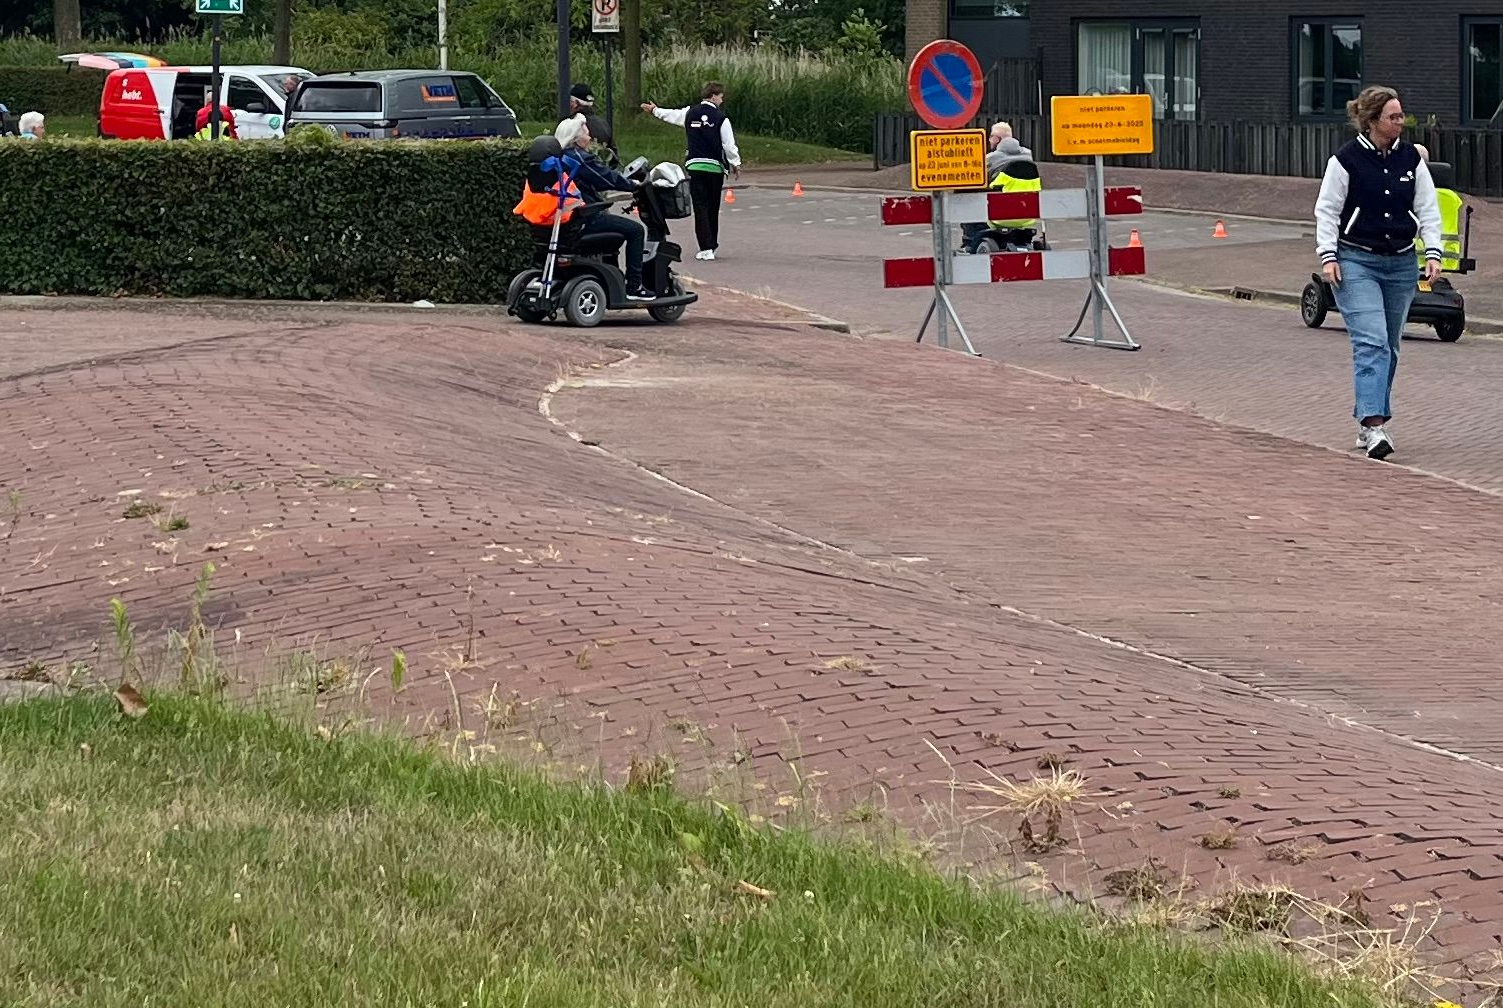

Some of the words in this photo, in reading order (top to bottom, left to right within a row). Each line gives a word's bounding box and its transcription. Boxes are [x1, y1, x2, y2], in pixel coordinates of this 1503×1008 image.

[919, 138, 938, 147] niet
[940, 136, 980, 147] parkeren
[927, 147, 973, 158] alstublieft
[921, 171, 981, 182] evenementen
